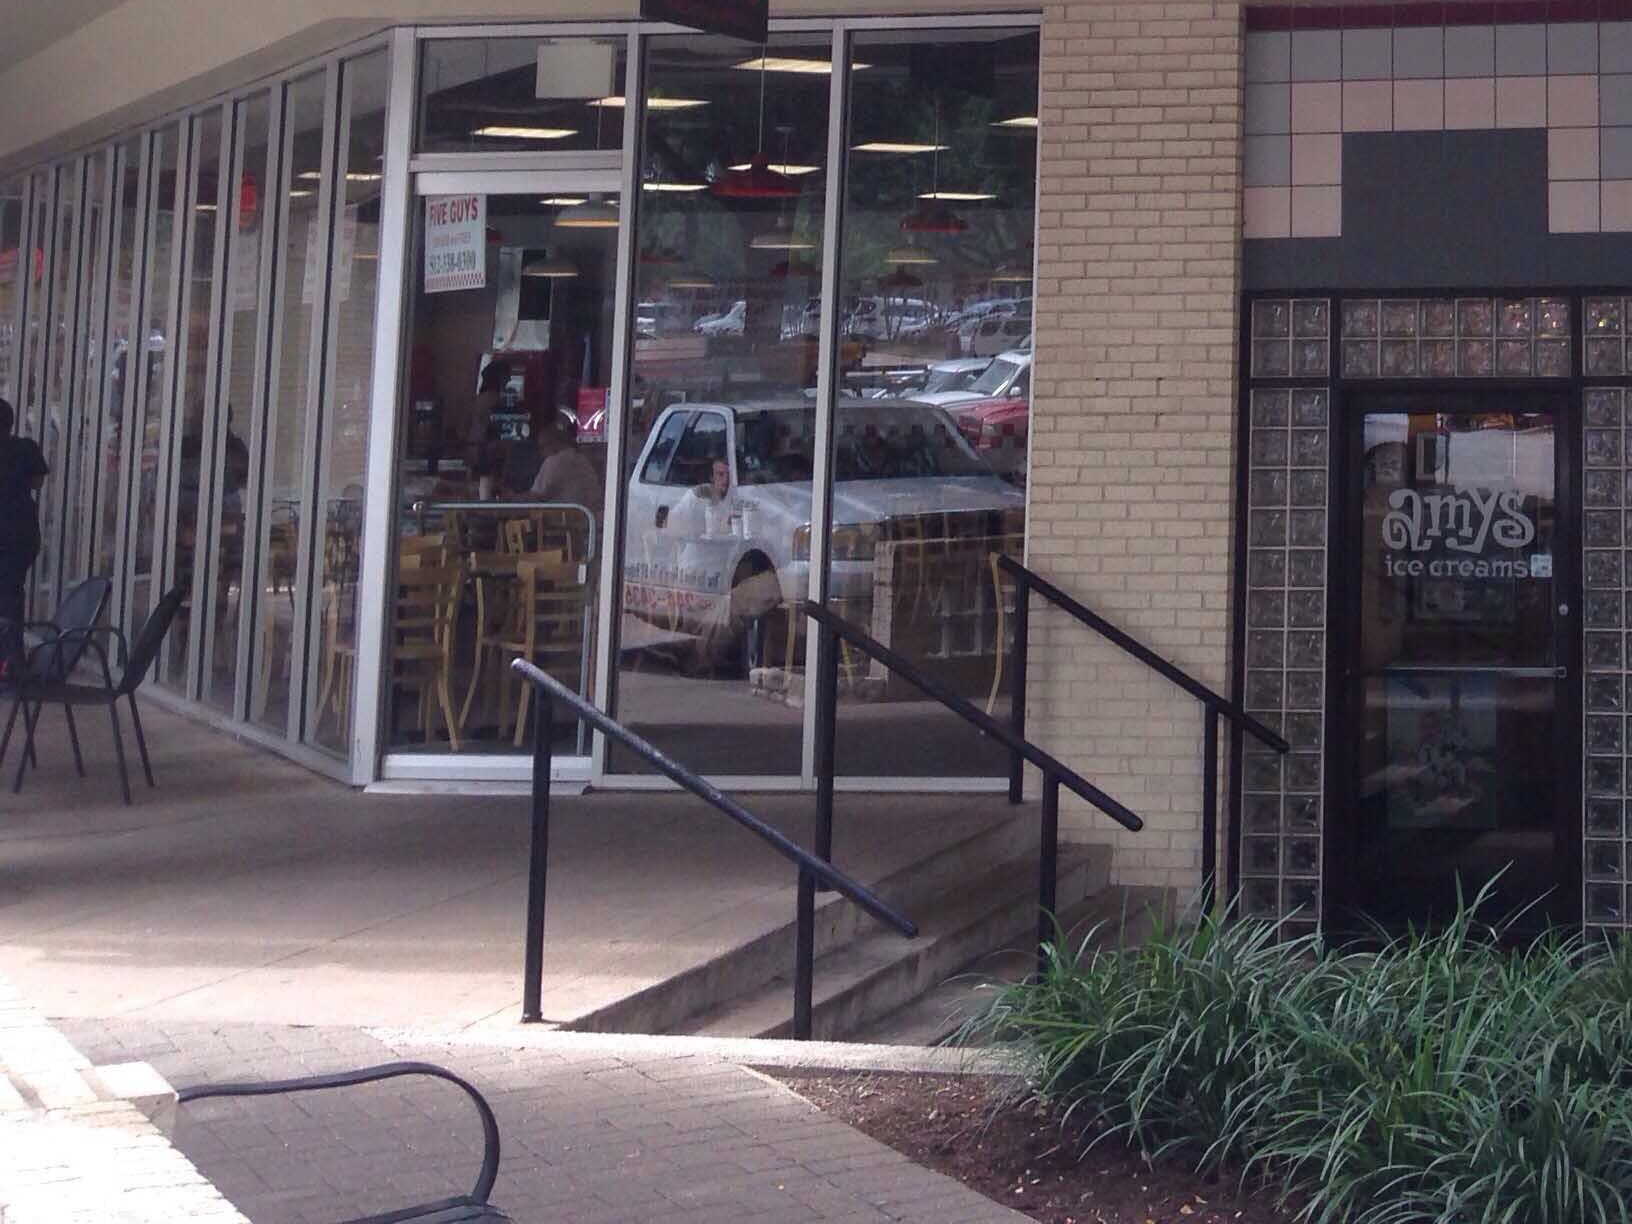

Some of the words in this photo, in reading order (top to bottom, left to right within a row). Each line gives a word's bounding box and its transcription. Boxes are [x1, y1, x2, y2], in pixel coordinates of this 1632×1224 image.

[449, 196, 479, 224] GUYS
[1384, 555, 1424, 577] ice
[1429, 558, 1528, 578] creams
